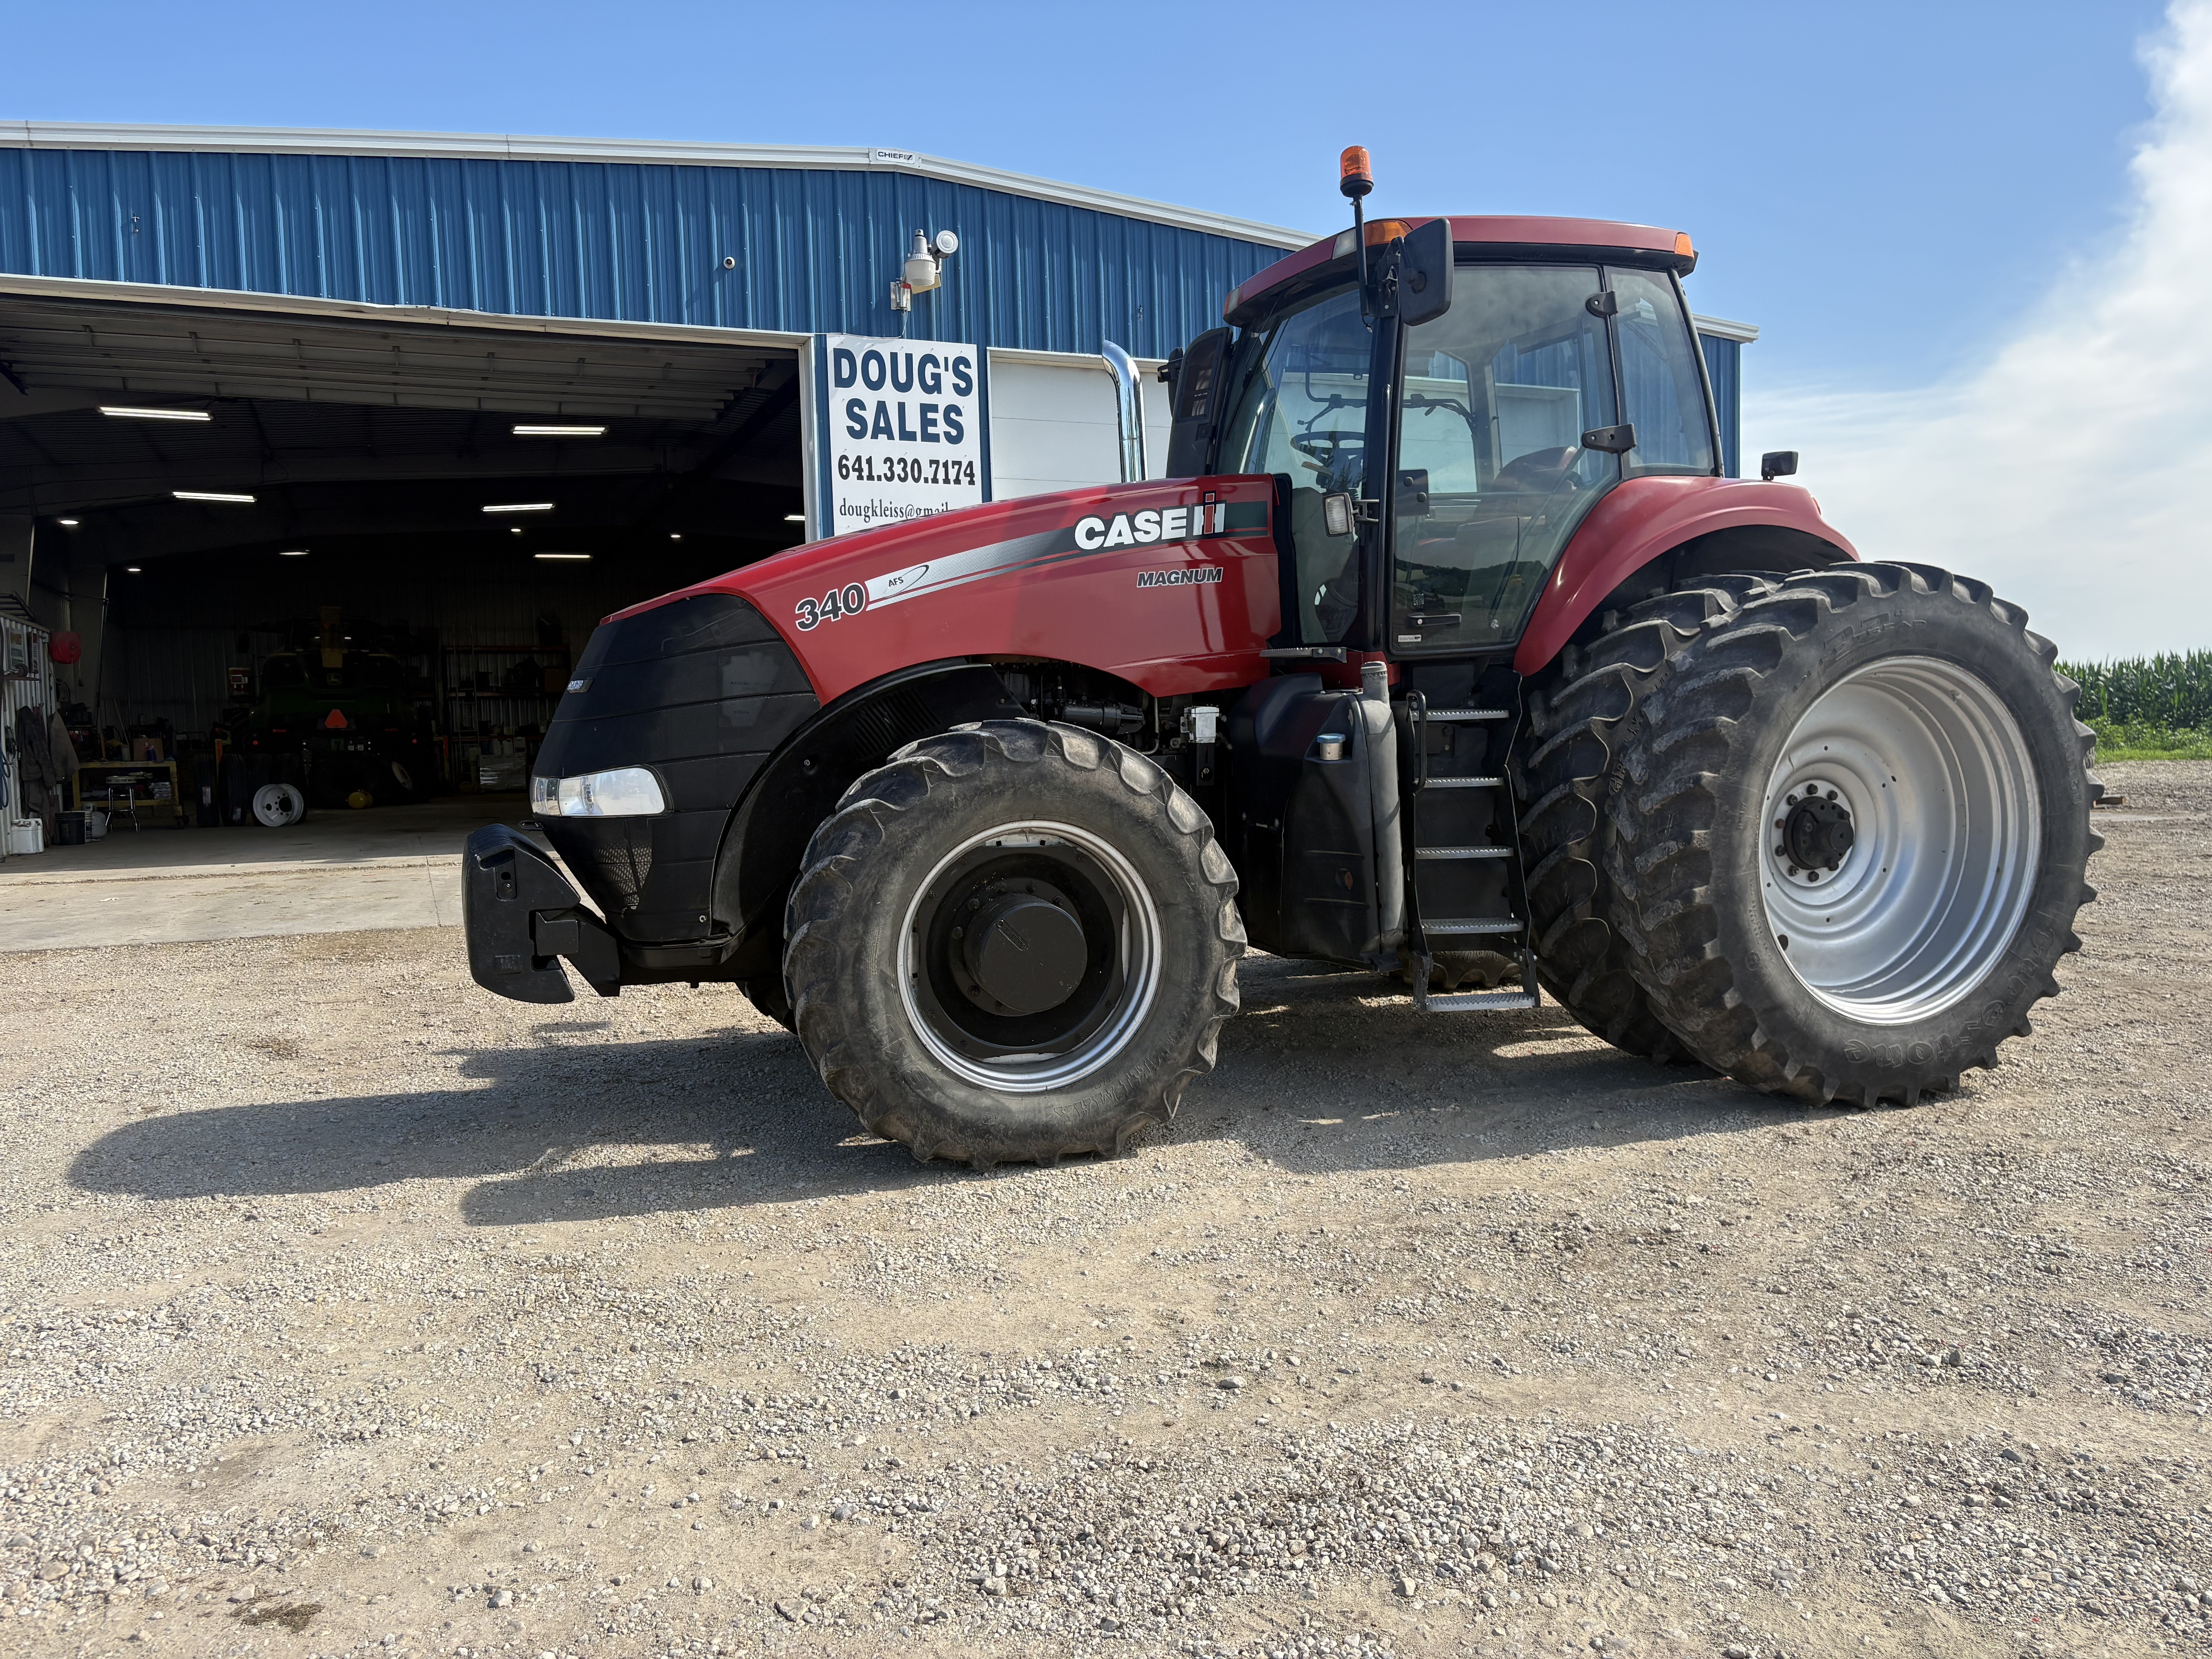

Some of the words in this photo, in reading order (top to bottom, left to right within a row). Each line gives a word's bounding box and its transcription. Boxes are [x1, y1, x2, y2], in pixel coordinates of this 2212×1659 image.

[833, 348, 973, 397] DOUG'S
[846, 398, 964, 445] SALES
[838, 454, 975, 486] 641.330.7174
[1075, 508, 1187, 550] CASE
[888, 576, 904, 587] AFS
[1137, 567, 1223, 587] MAGNUM
[795, 582, 866, 631] 340
